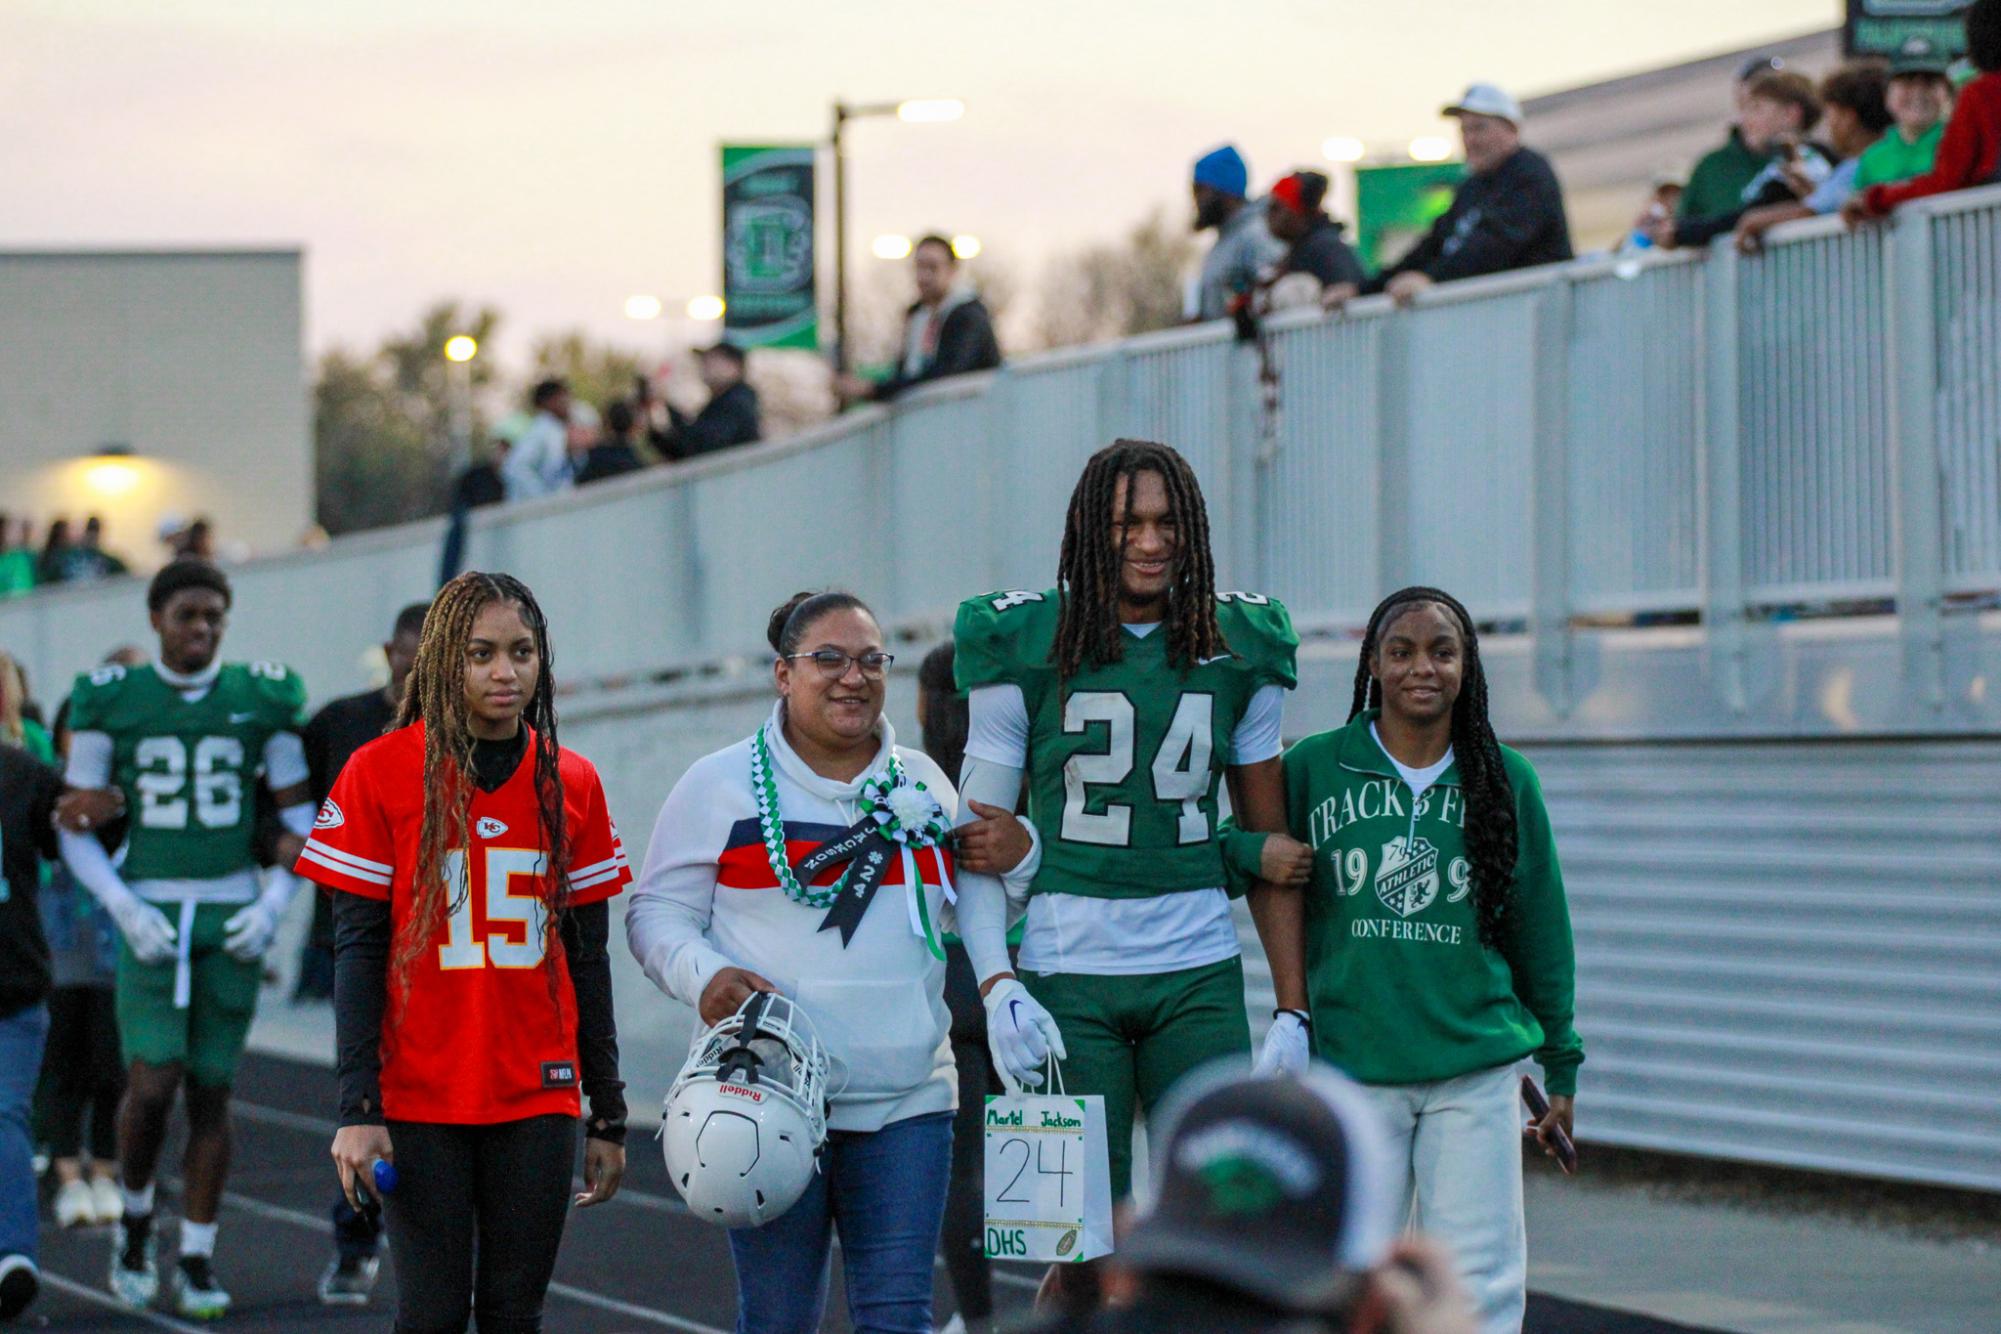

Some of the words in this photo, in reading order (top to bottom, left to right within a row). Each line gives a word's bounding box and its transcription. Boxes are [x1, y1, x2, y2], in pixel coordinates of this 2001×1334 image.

[136, 734, 244, 829] 26
[1060, 690, 1215, 847] 24
[1309, 779, 1405, 850] TRACK
[804, 826, 878, 870] JACKSON
[1379, 853, 1435, 895] ATHLETIC
[1447, 856, 1472, 903] 9
[438, 846, 549, 971] 15
[1351, 918, 1462, 945] CONFERENCE
[719, 1084, 762, 1102] Riddell
[1040, 1110, 1082, 1128] Jackson
[996, 1138, 1074, 1208] 24
[987, 1227, 1028, 1256] DHS
